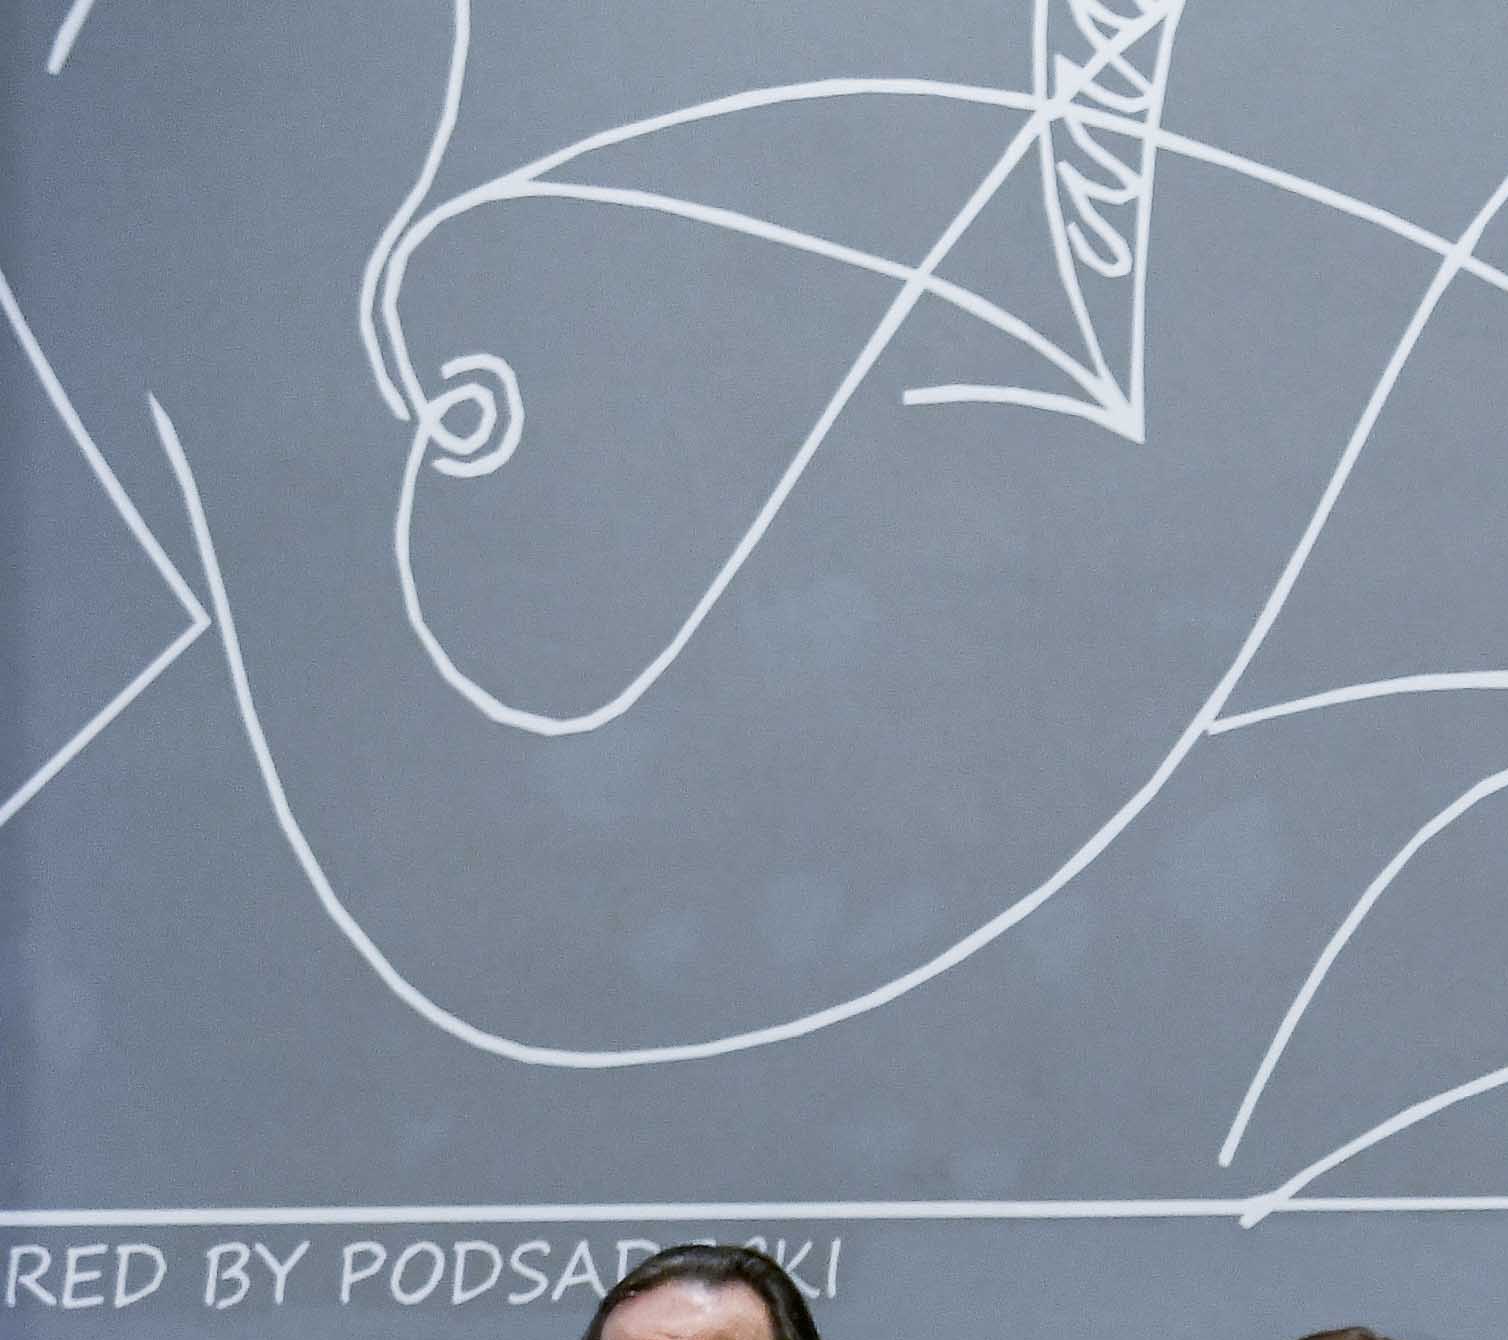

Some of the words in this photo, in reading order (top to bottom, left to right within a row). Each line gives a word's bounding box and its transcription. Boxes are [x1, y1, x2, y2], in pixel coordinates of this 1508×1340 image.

[6, 1242, 167, 1310] RED
[204, 1240, 311, 1310] BY
[340, 1237, 842, 1305] PODSADKI
